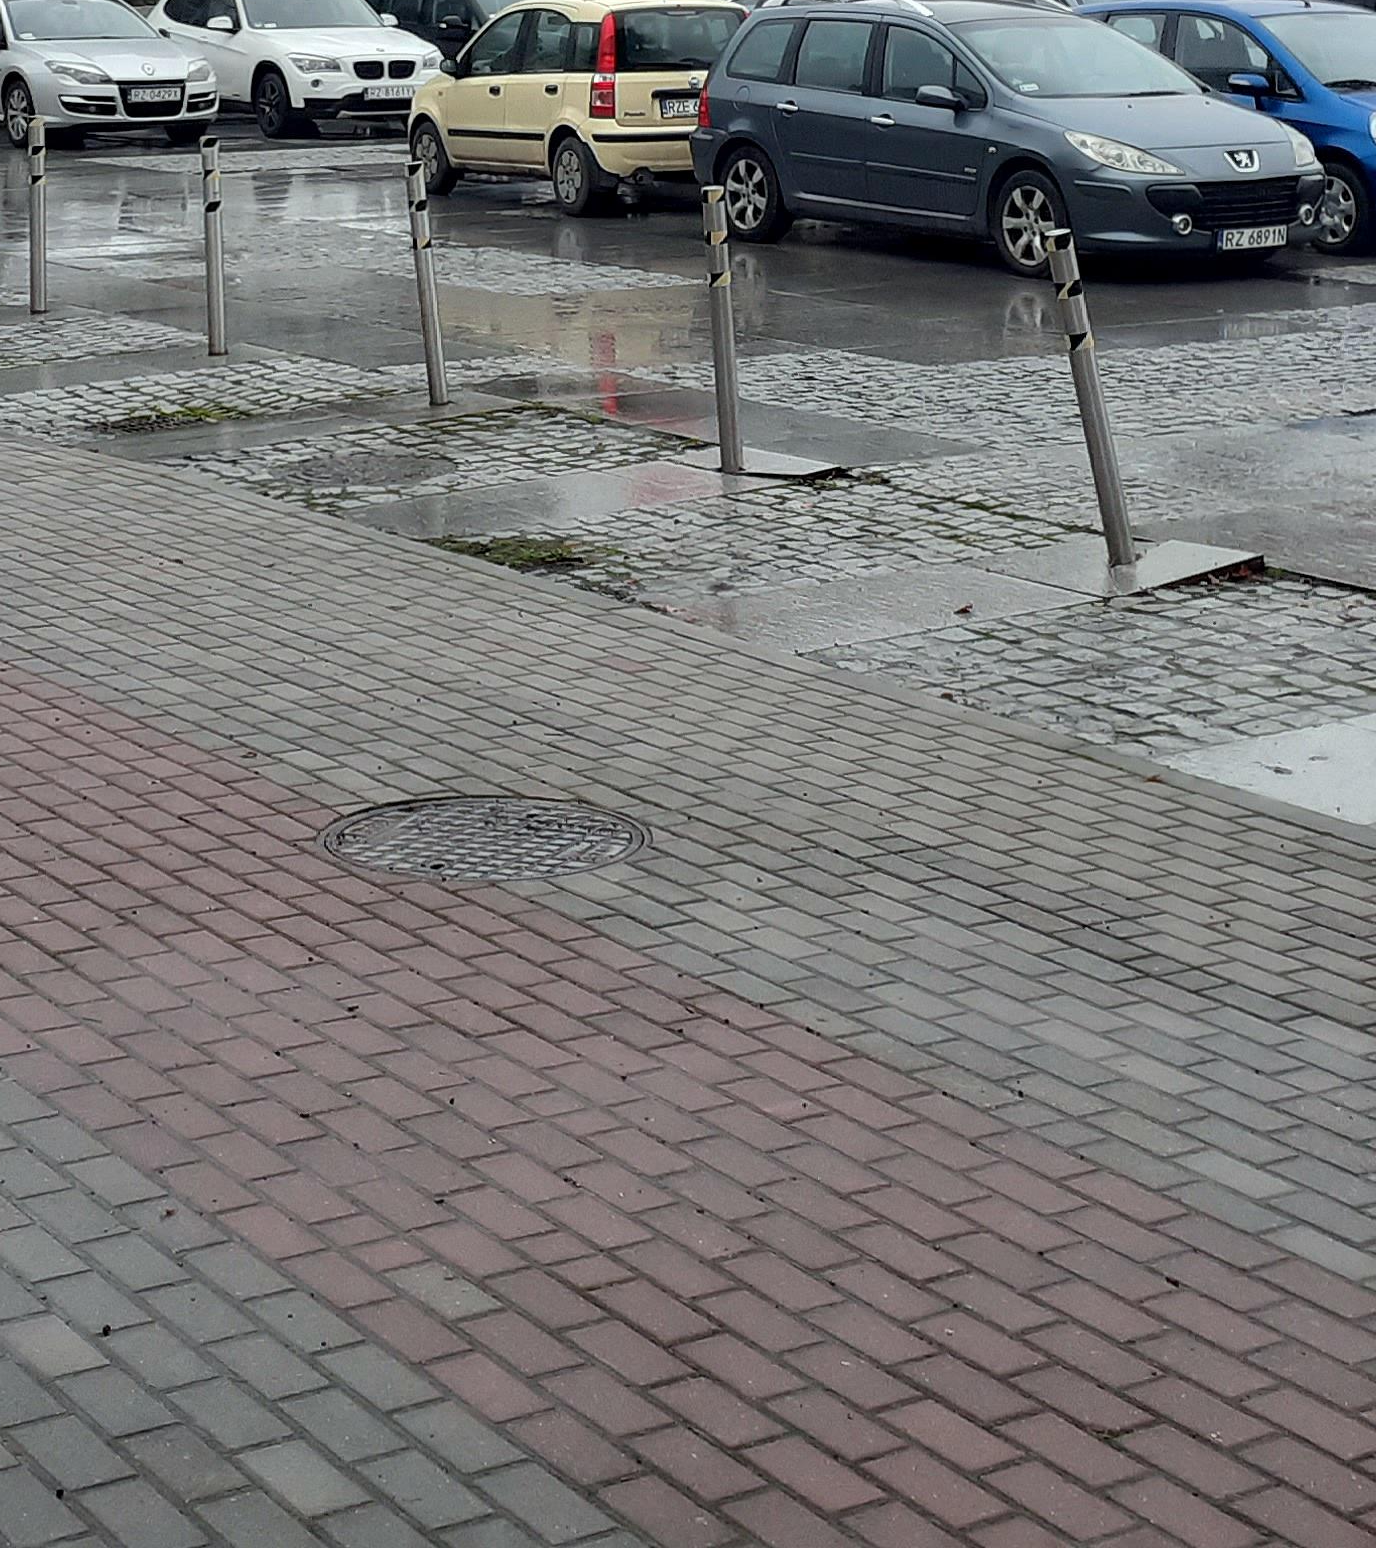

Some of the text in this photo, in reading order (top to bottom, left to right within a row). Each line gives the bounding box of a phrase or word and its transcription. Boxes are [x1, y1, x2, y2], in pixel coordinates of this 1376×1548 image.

[667, 100, 690, 113] RZE
[1225, 227, 1285, 248] RZ 6891N
